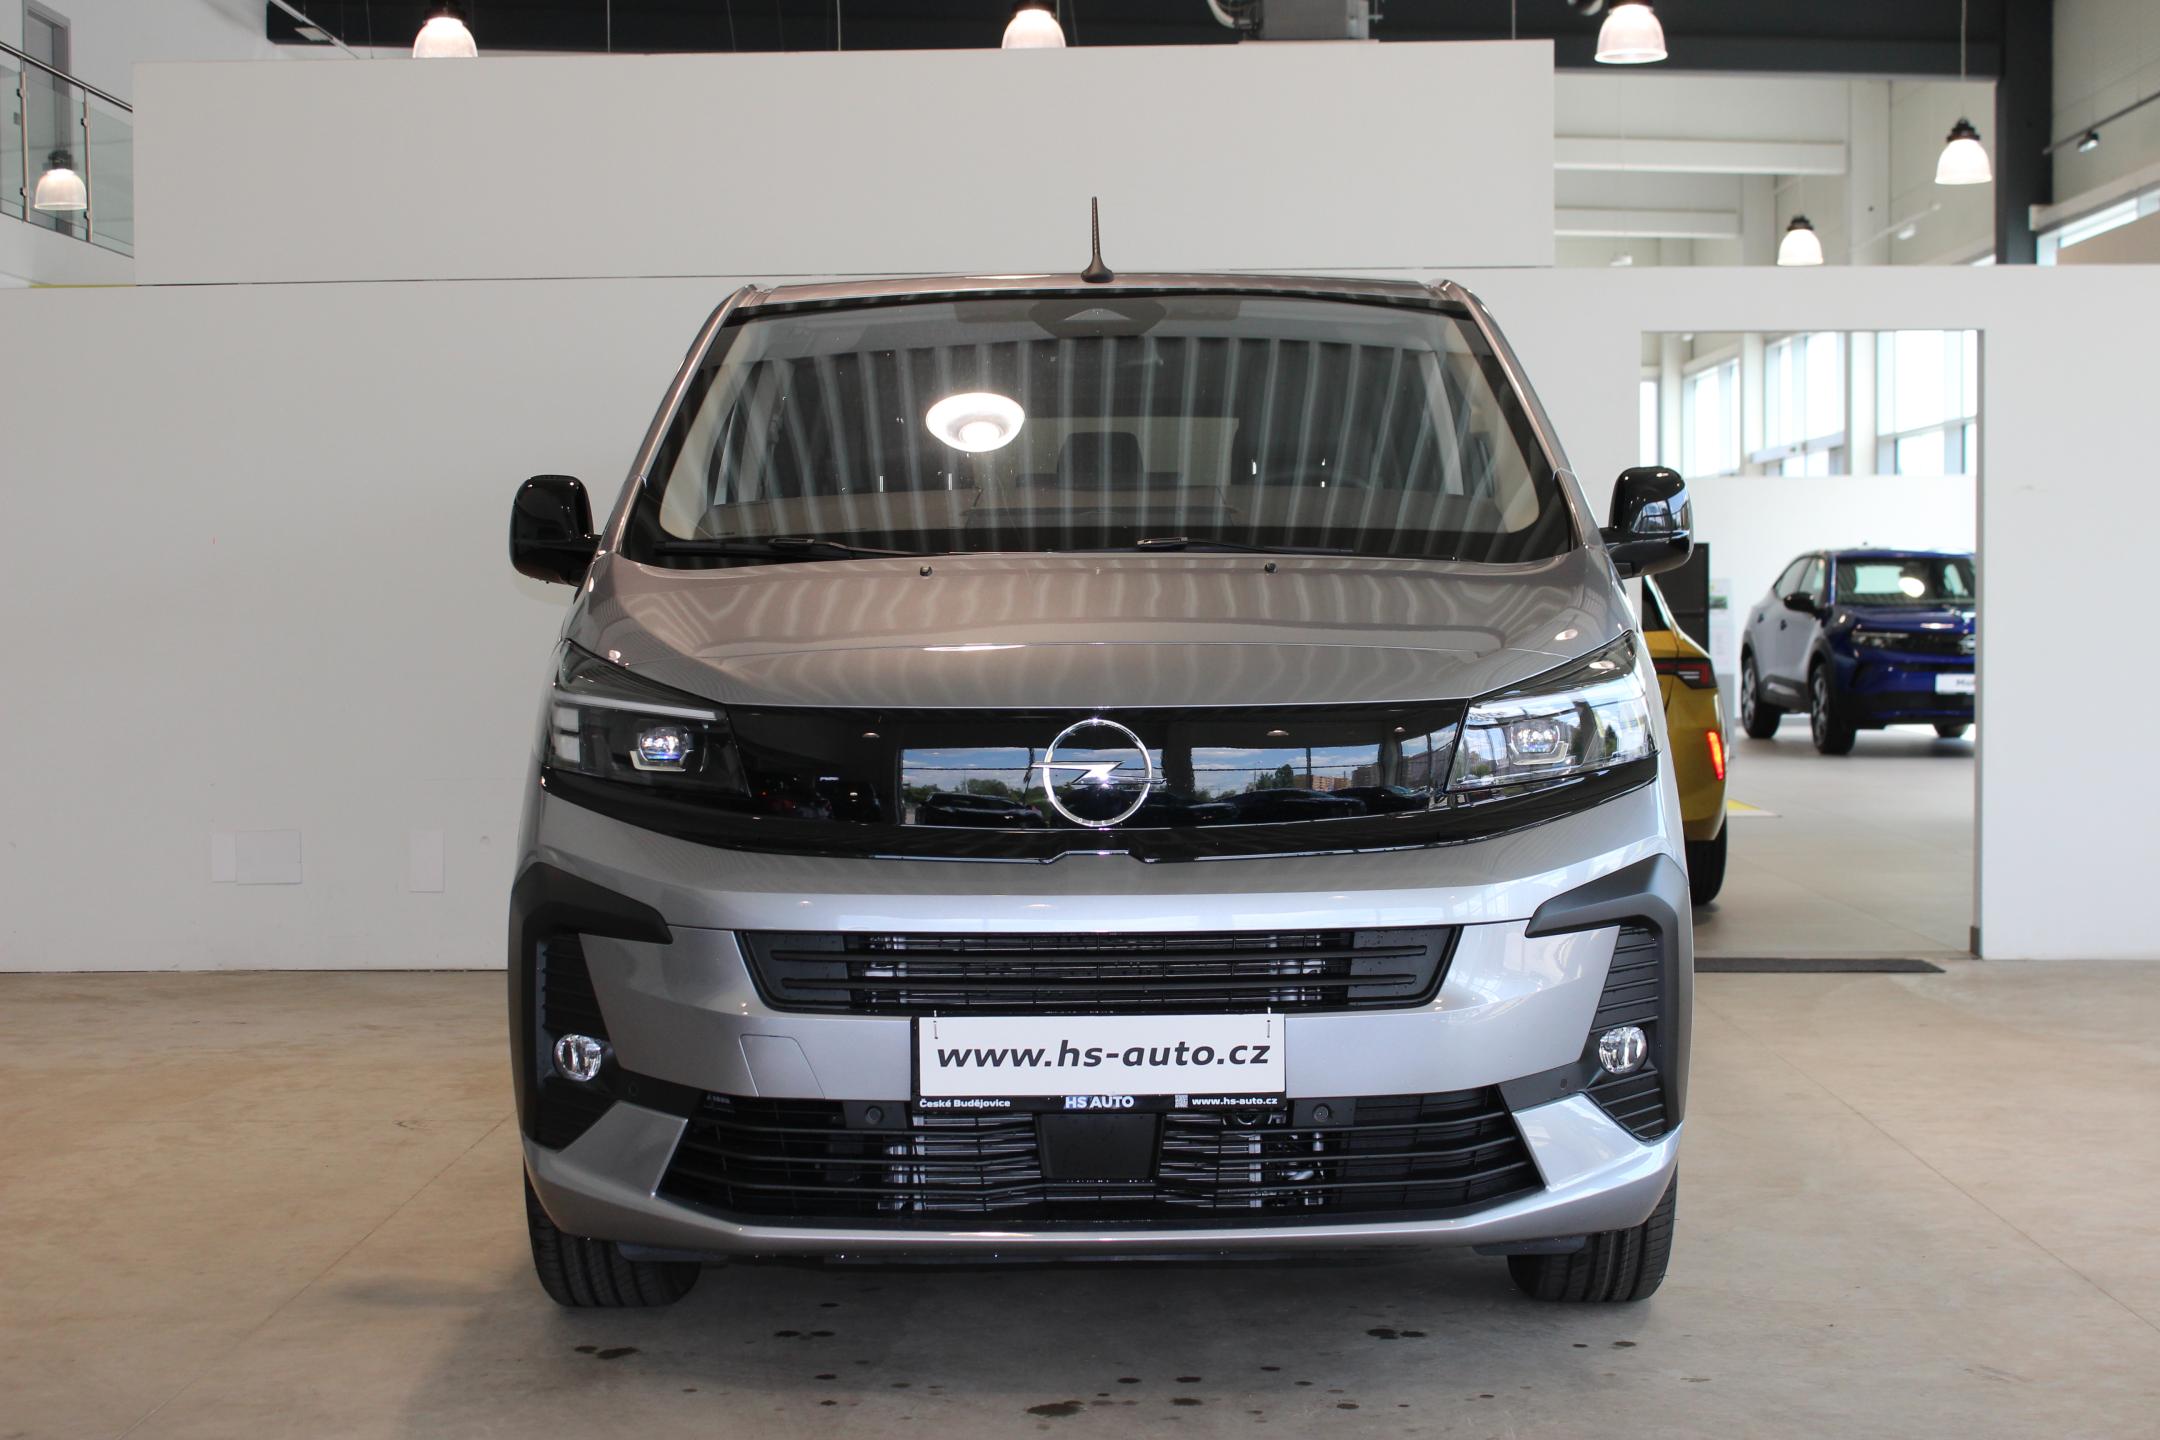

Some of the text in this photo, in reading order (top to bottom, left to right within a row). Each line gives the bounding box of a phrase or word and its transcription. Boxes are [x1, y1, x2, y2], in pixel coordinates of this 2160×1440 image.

[937, 1040, 1271, 1068] www.hs-auto.cz
[919, 1099, 1011, 1109] České Budějovice
[1065, 1095, 1134, 1109] HS AUTO
[1192, 1096, 1278, 1105] www.hs-auto.cz
